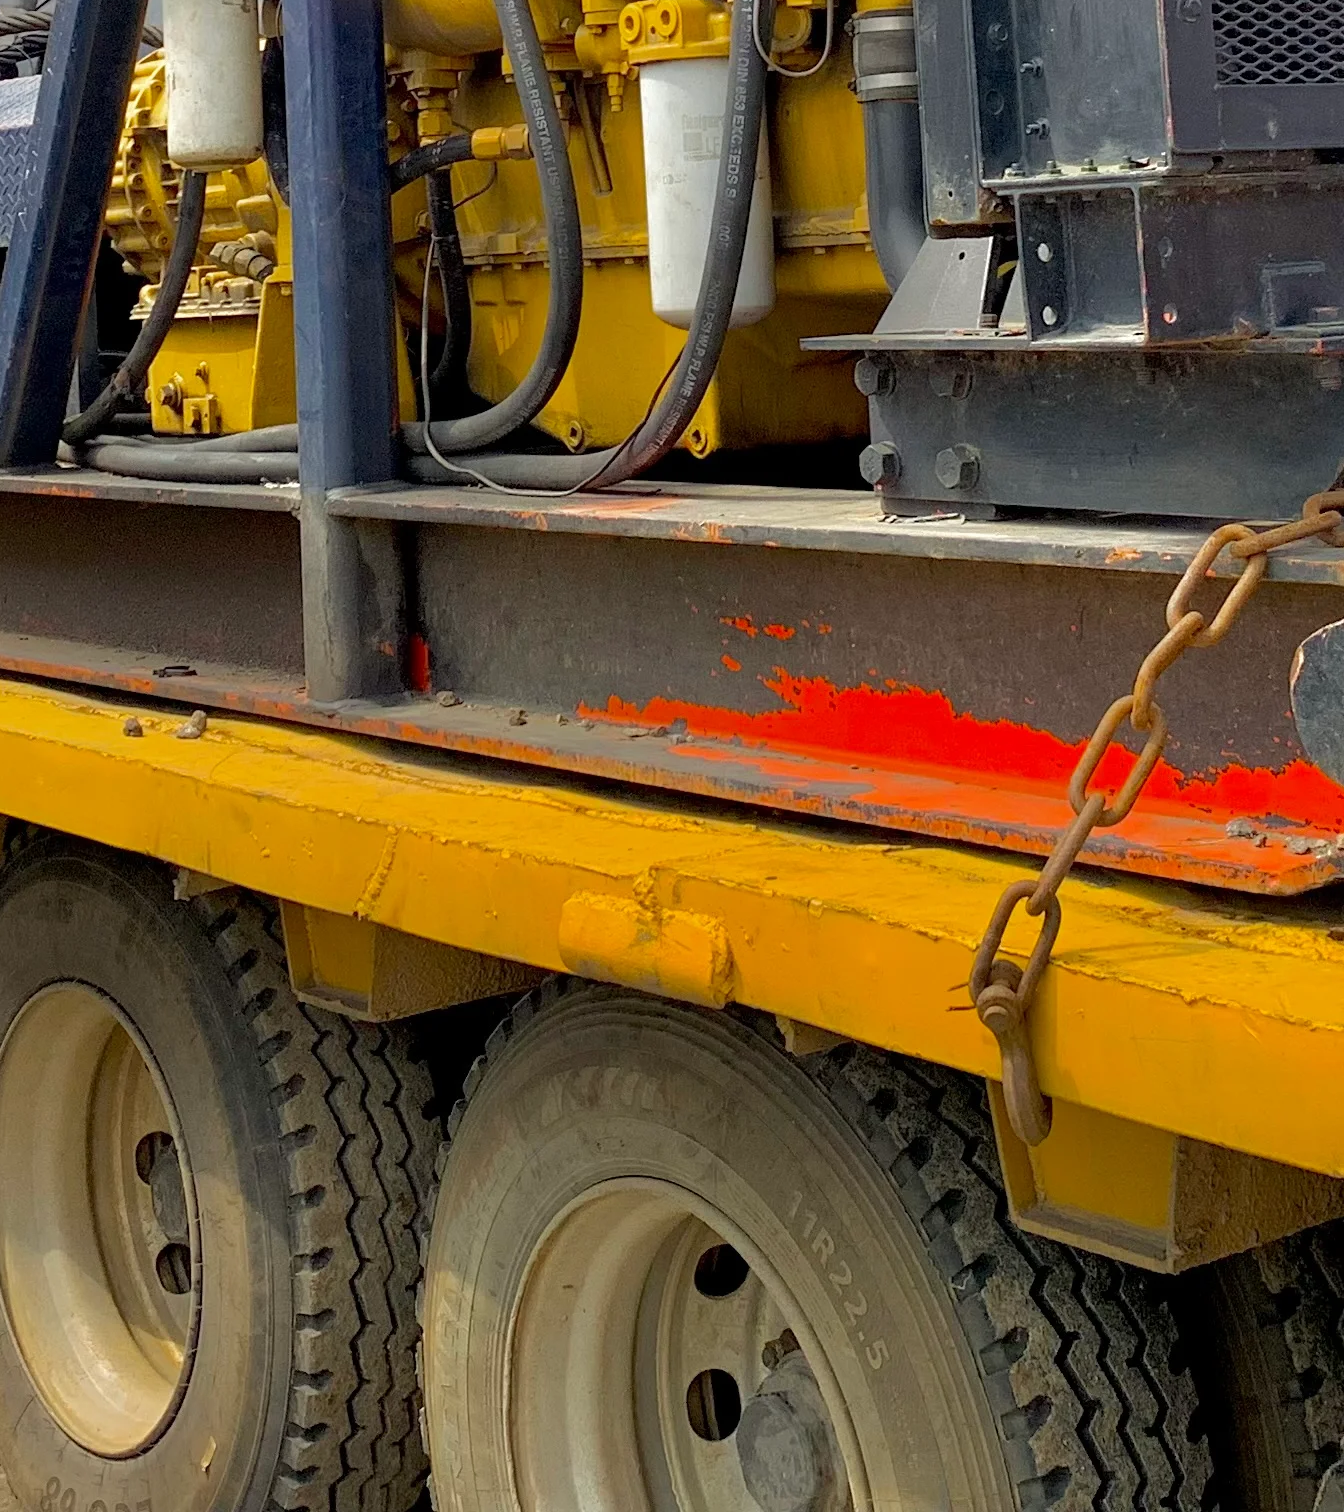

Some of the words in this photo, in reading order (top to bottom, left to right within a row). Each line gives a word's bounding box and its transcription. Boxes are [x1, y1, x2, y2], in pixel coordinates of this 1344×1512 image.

[514, 41, 537, 88] FLAME
[528, 88, 556, 162] RESISTANT
[679, 358, 703, 398] FLAME
[787, 1190, 891, 1371] 11R22.5
